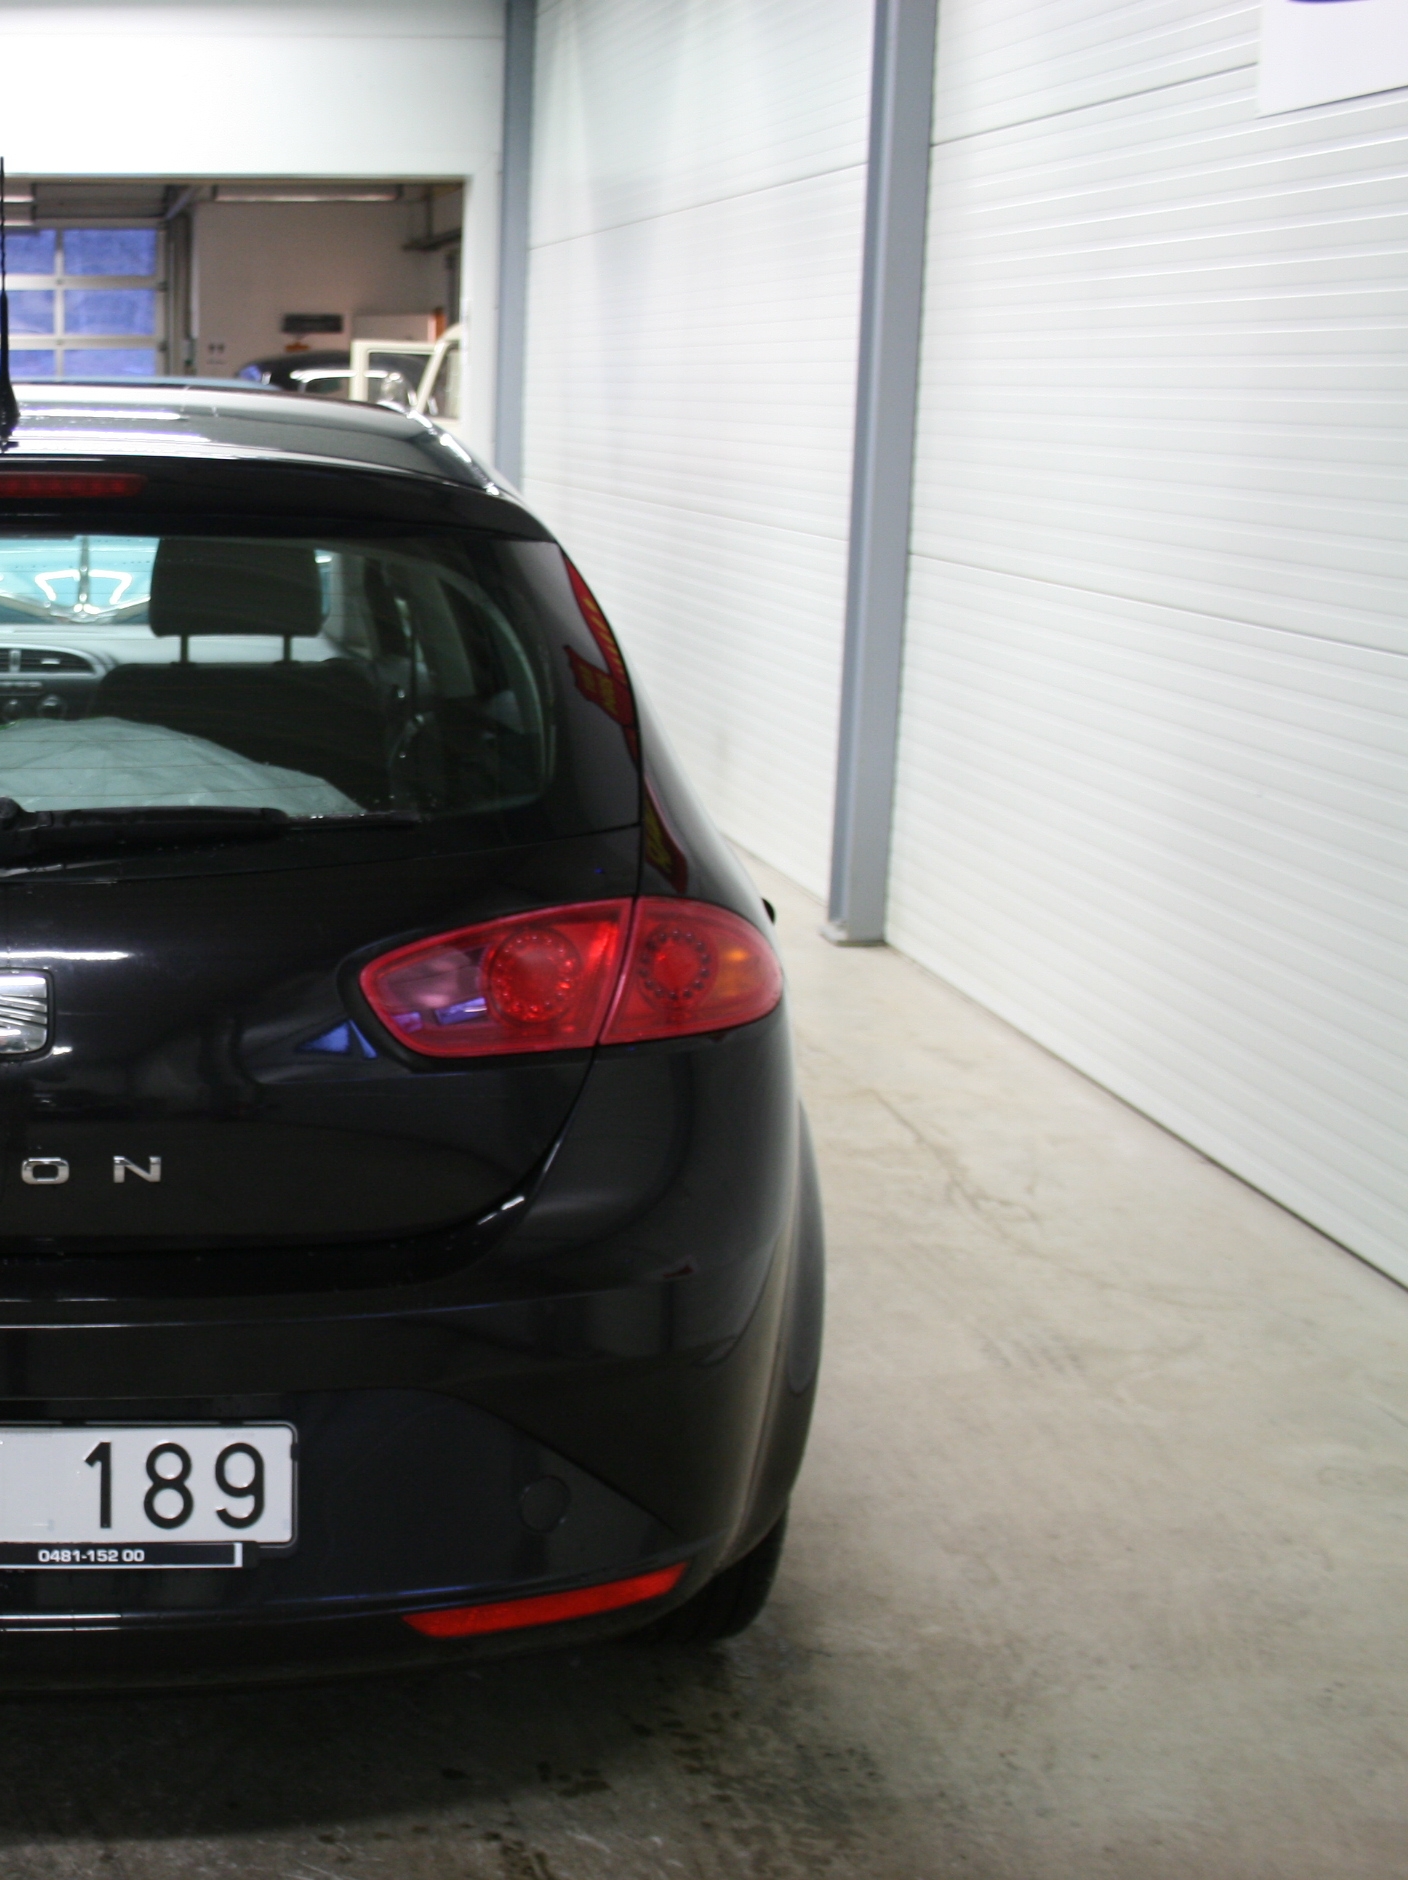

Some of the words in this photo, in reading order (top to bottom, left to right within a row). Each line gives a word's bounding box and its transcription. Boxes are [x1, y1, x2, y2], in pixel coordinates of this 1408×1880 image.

[83, 1441, 265, 1529] 189
[37, 1549, 119, 1563] 0481-152
[122, 1549, 145, 1562] 00
